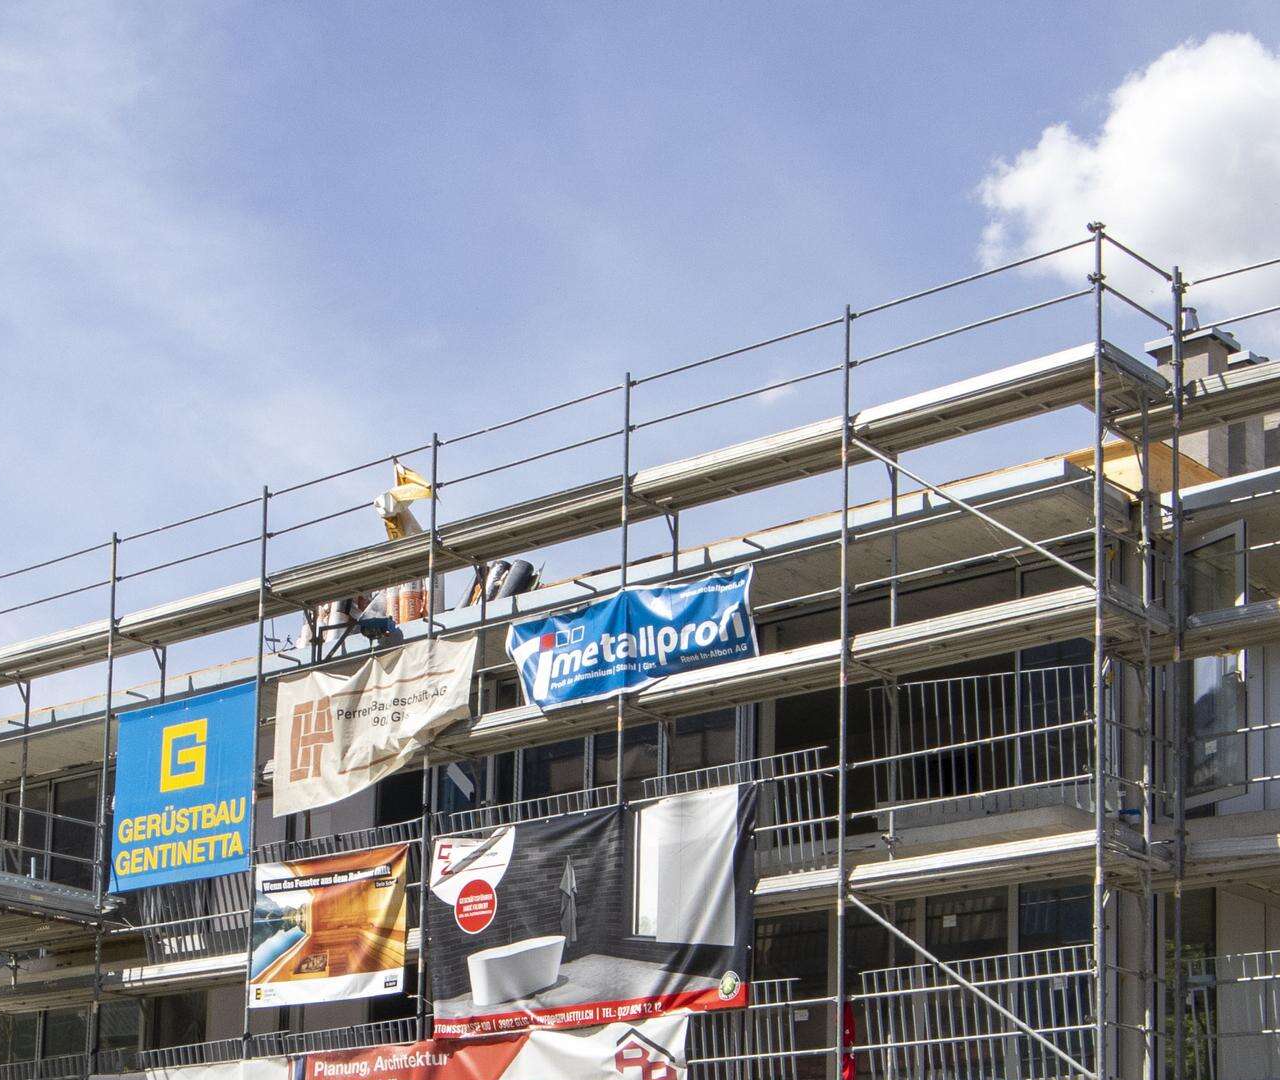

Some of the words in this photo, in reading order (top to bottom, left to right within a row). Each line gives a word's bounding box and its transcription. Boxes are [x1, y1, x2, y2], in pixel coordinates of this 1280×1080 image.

[735, 643, 748, 653] AG
[117, 796, 246, 844] GERÜSTBAU
[115, 831, 244, 876] GENTINETTA
[263, 881, 282, 892] Wenn
[283, 879, 294, 890] das
[294, 876, 320, 888] Fenster
[320, 876, 332, 885] aus
[333, 874, 348, 884] dem
[643, 1003, 653, 1014] 12
[654, 1002, 663, 1012] 12
[314, 1060, 370, 1077] Planung,
[374, 1051, 449, 1071] Architektur
